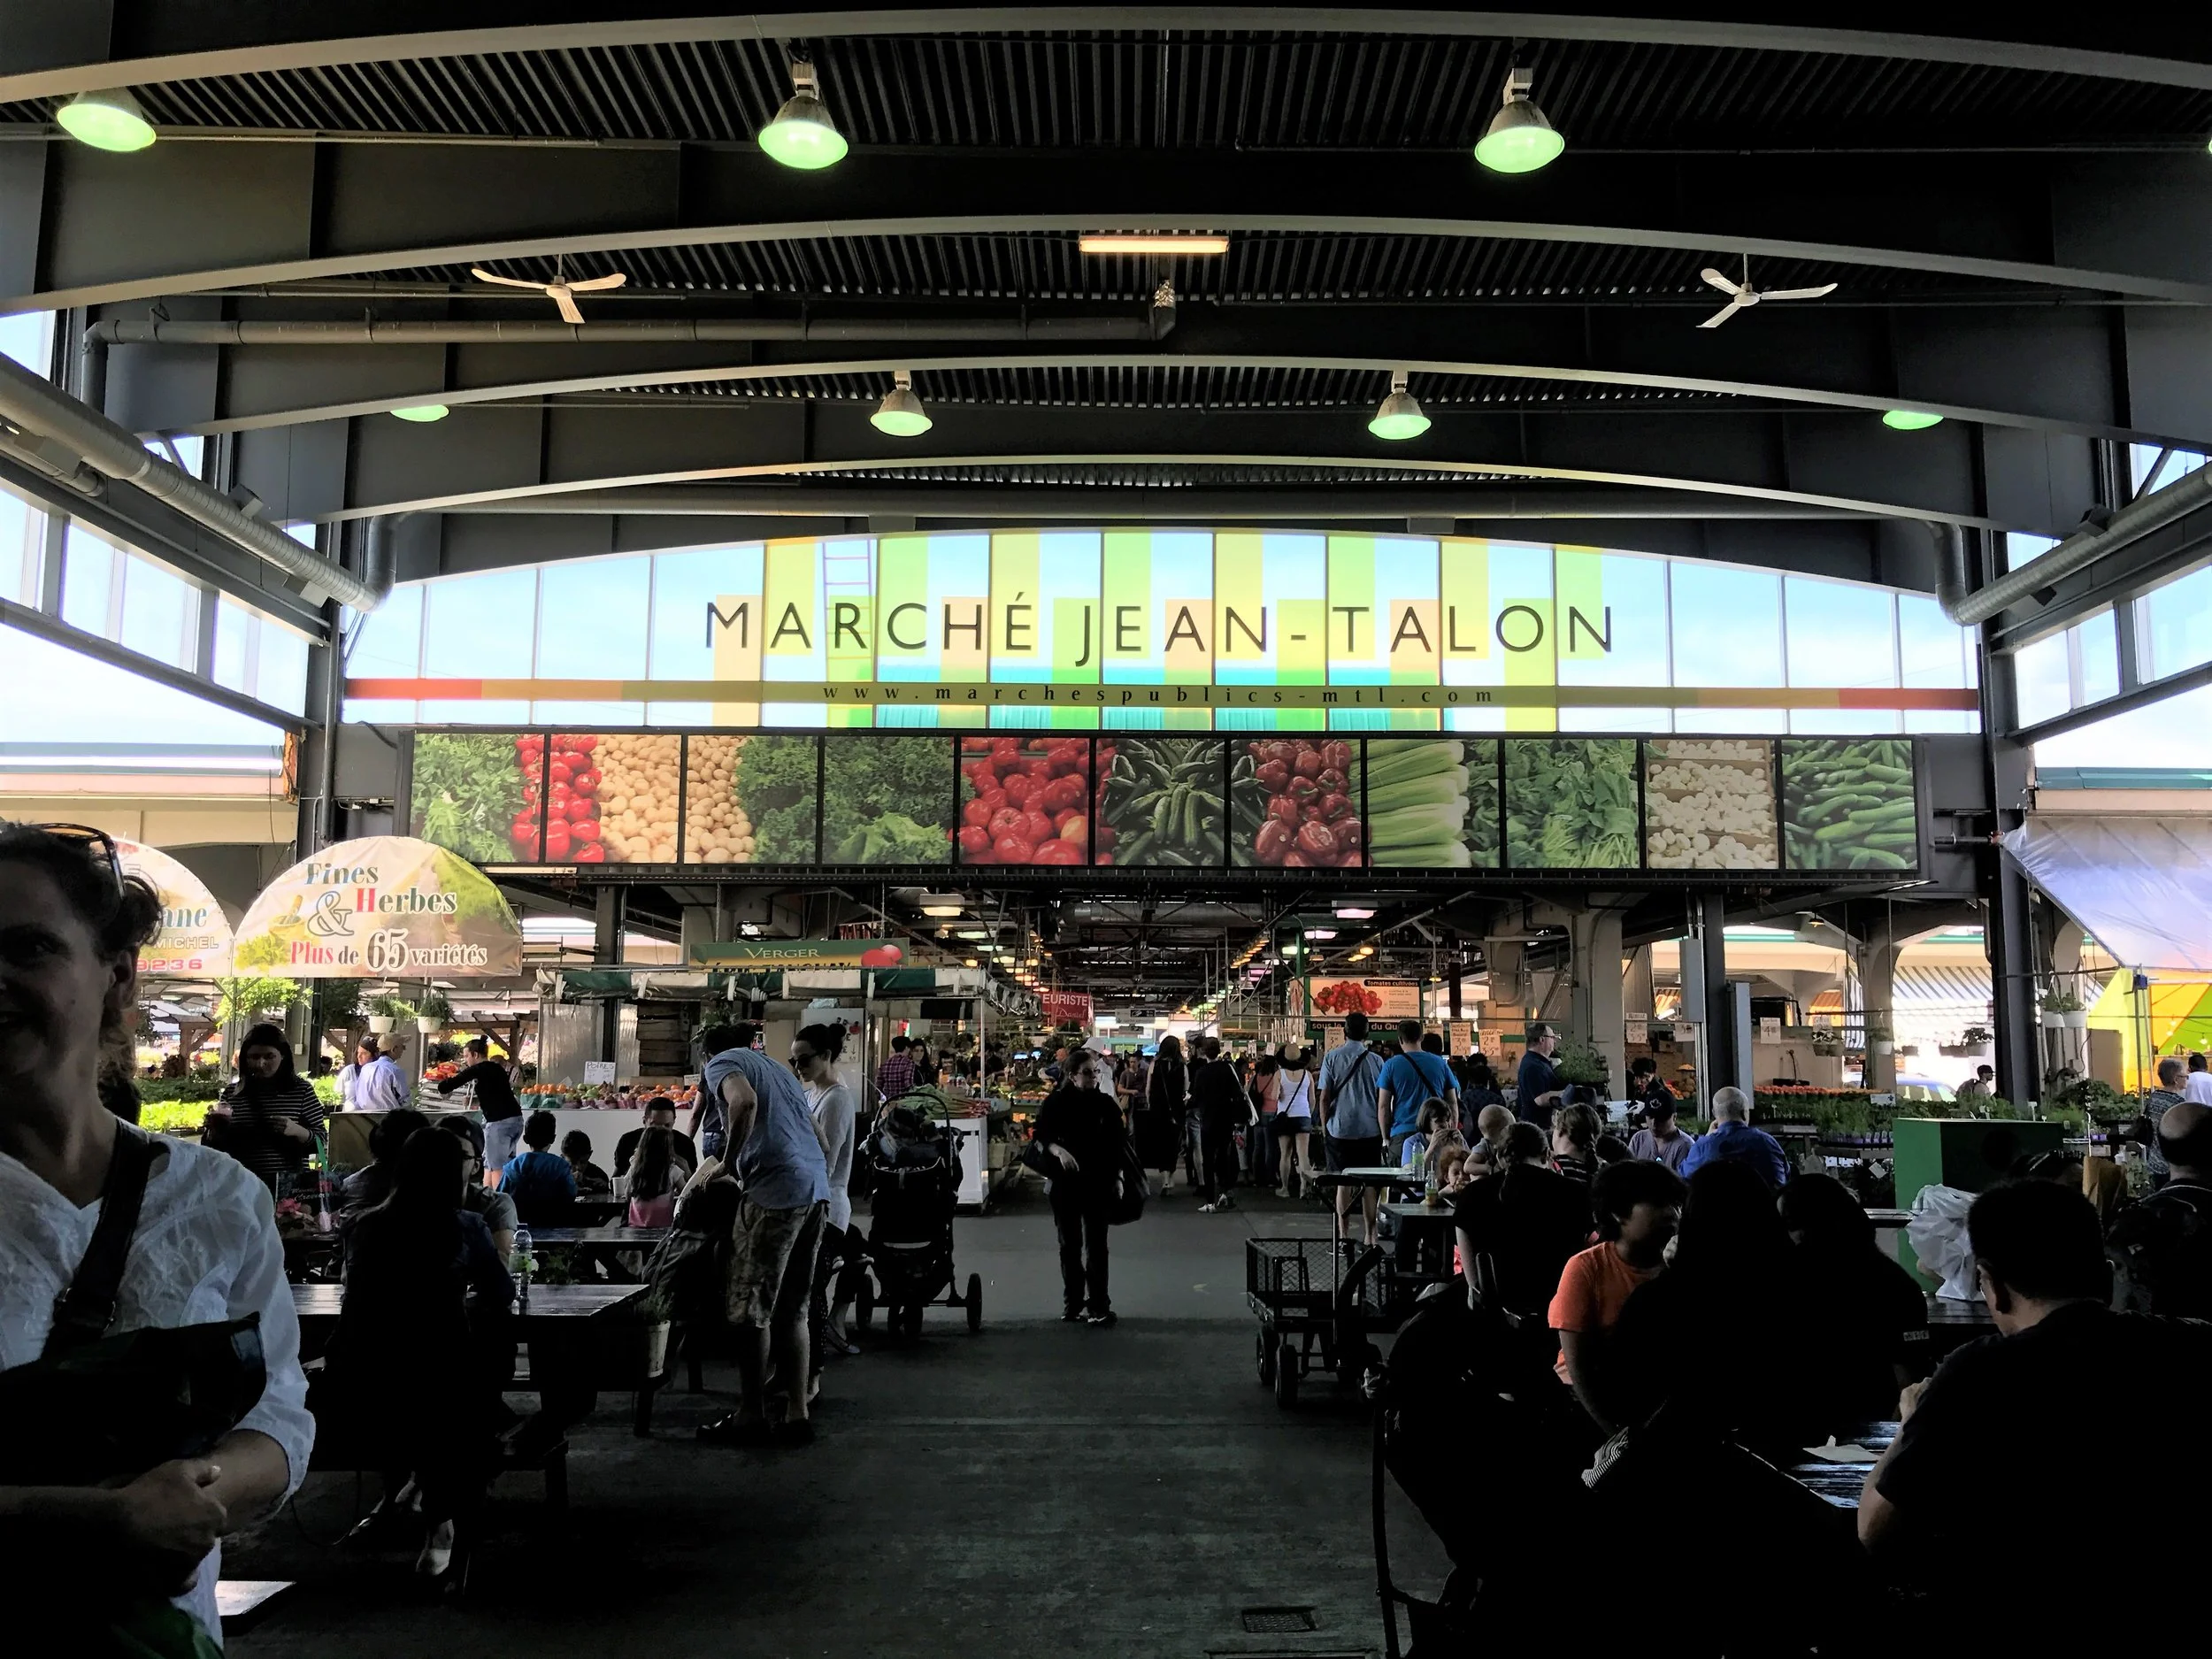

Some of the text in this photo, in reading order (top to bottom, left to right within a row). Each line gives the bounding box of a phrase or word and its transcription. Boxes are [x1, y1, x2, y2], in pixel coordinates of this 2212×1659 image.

[705, 591, 1612, 667] MARCHÉ JEAN-TALON
[823, 686, 1492, 706] www.marchespublics-mtl.com
[304, 862, 380, 885] Fines
[307, 887, 457, 937] & Herbes
[290, 930, 488, 970] Plus de 65 variétés
